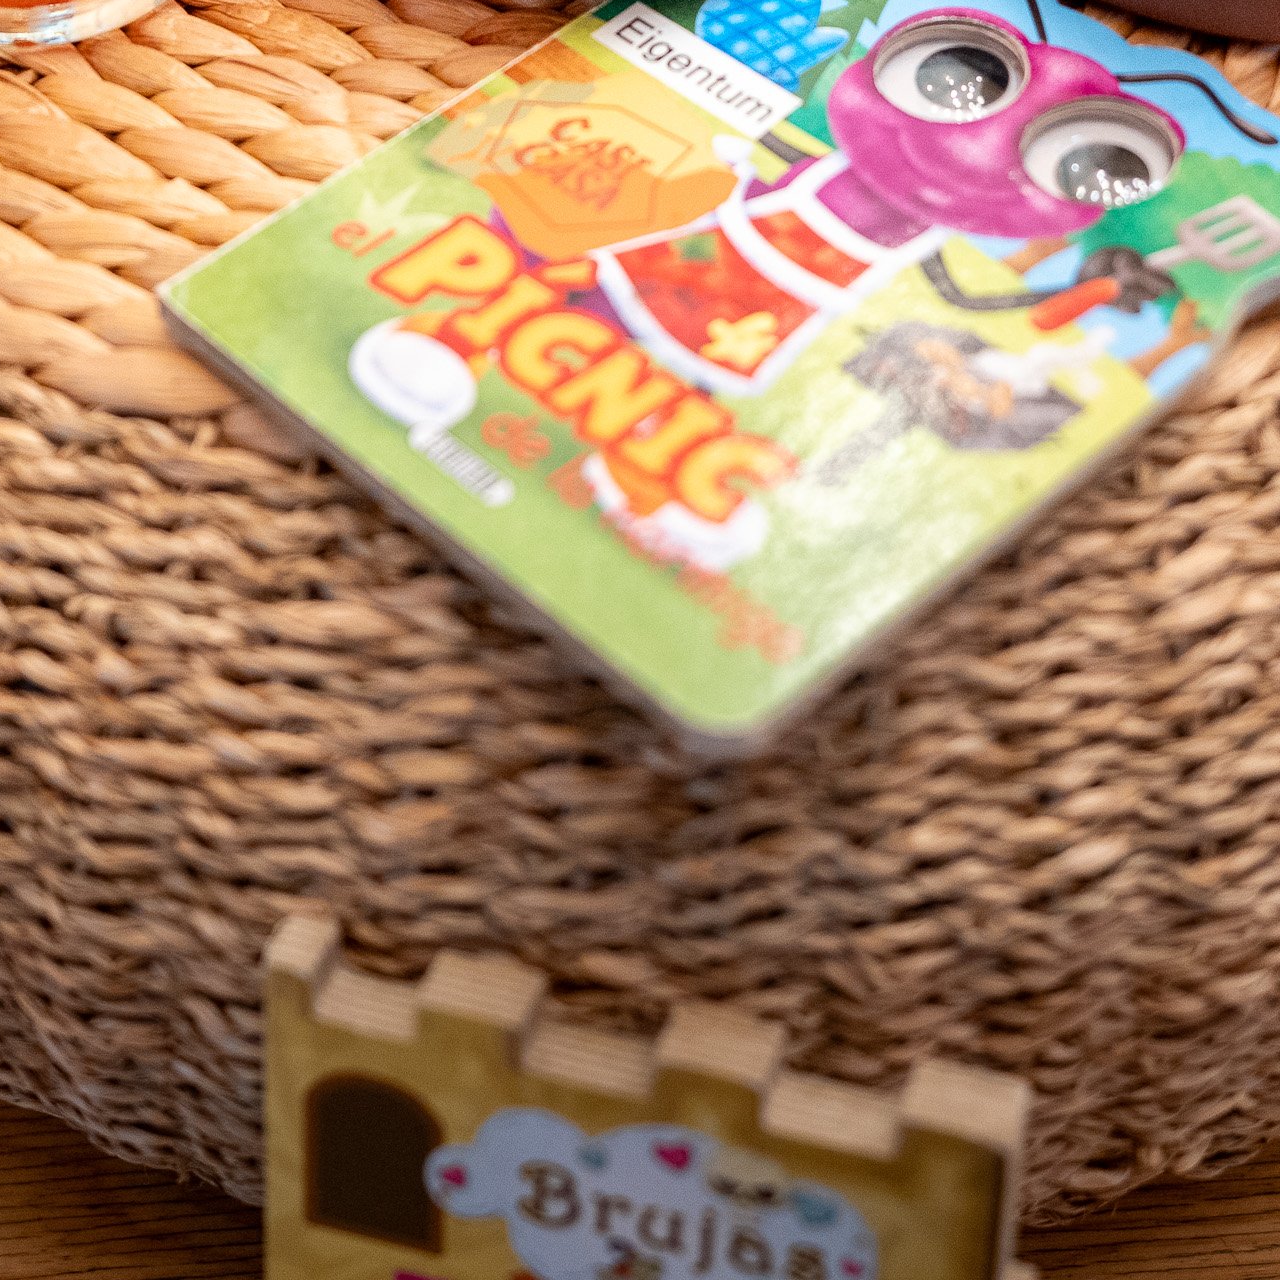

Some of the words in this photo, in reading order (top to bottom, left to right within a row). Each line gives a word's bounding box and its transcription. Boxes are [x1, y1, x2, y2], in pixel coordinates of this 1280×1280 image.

[615, 16, 773, 124] Eigentum
[331, 220, 396, 258] el
[481, 411, 552, 471] de
[515, 1158, 827, 1280] Brujas
